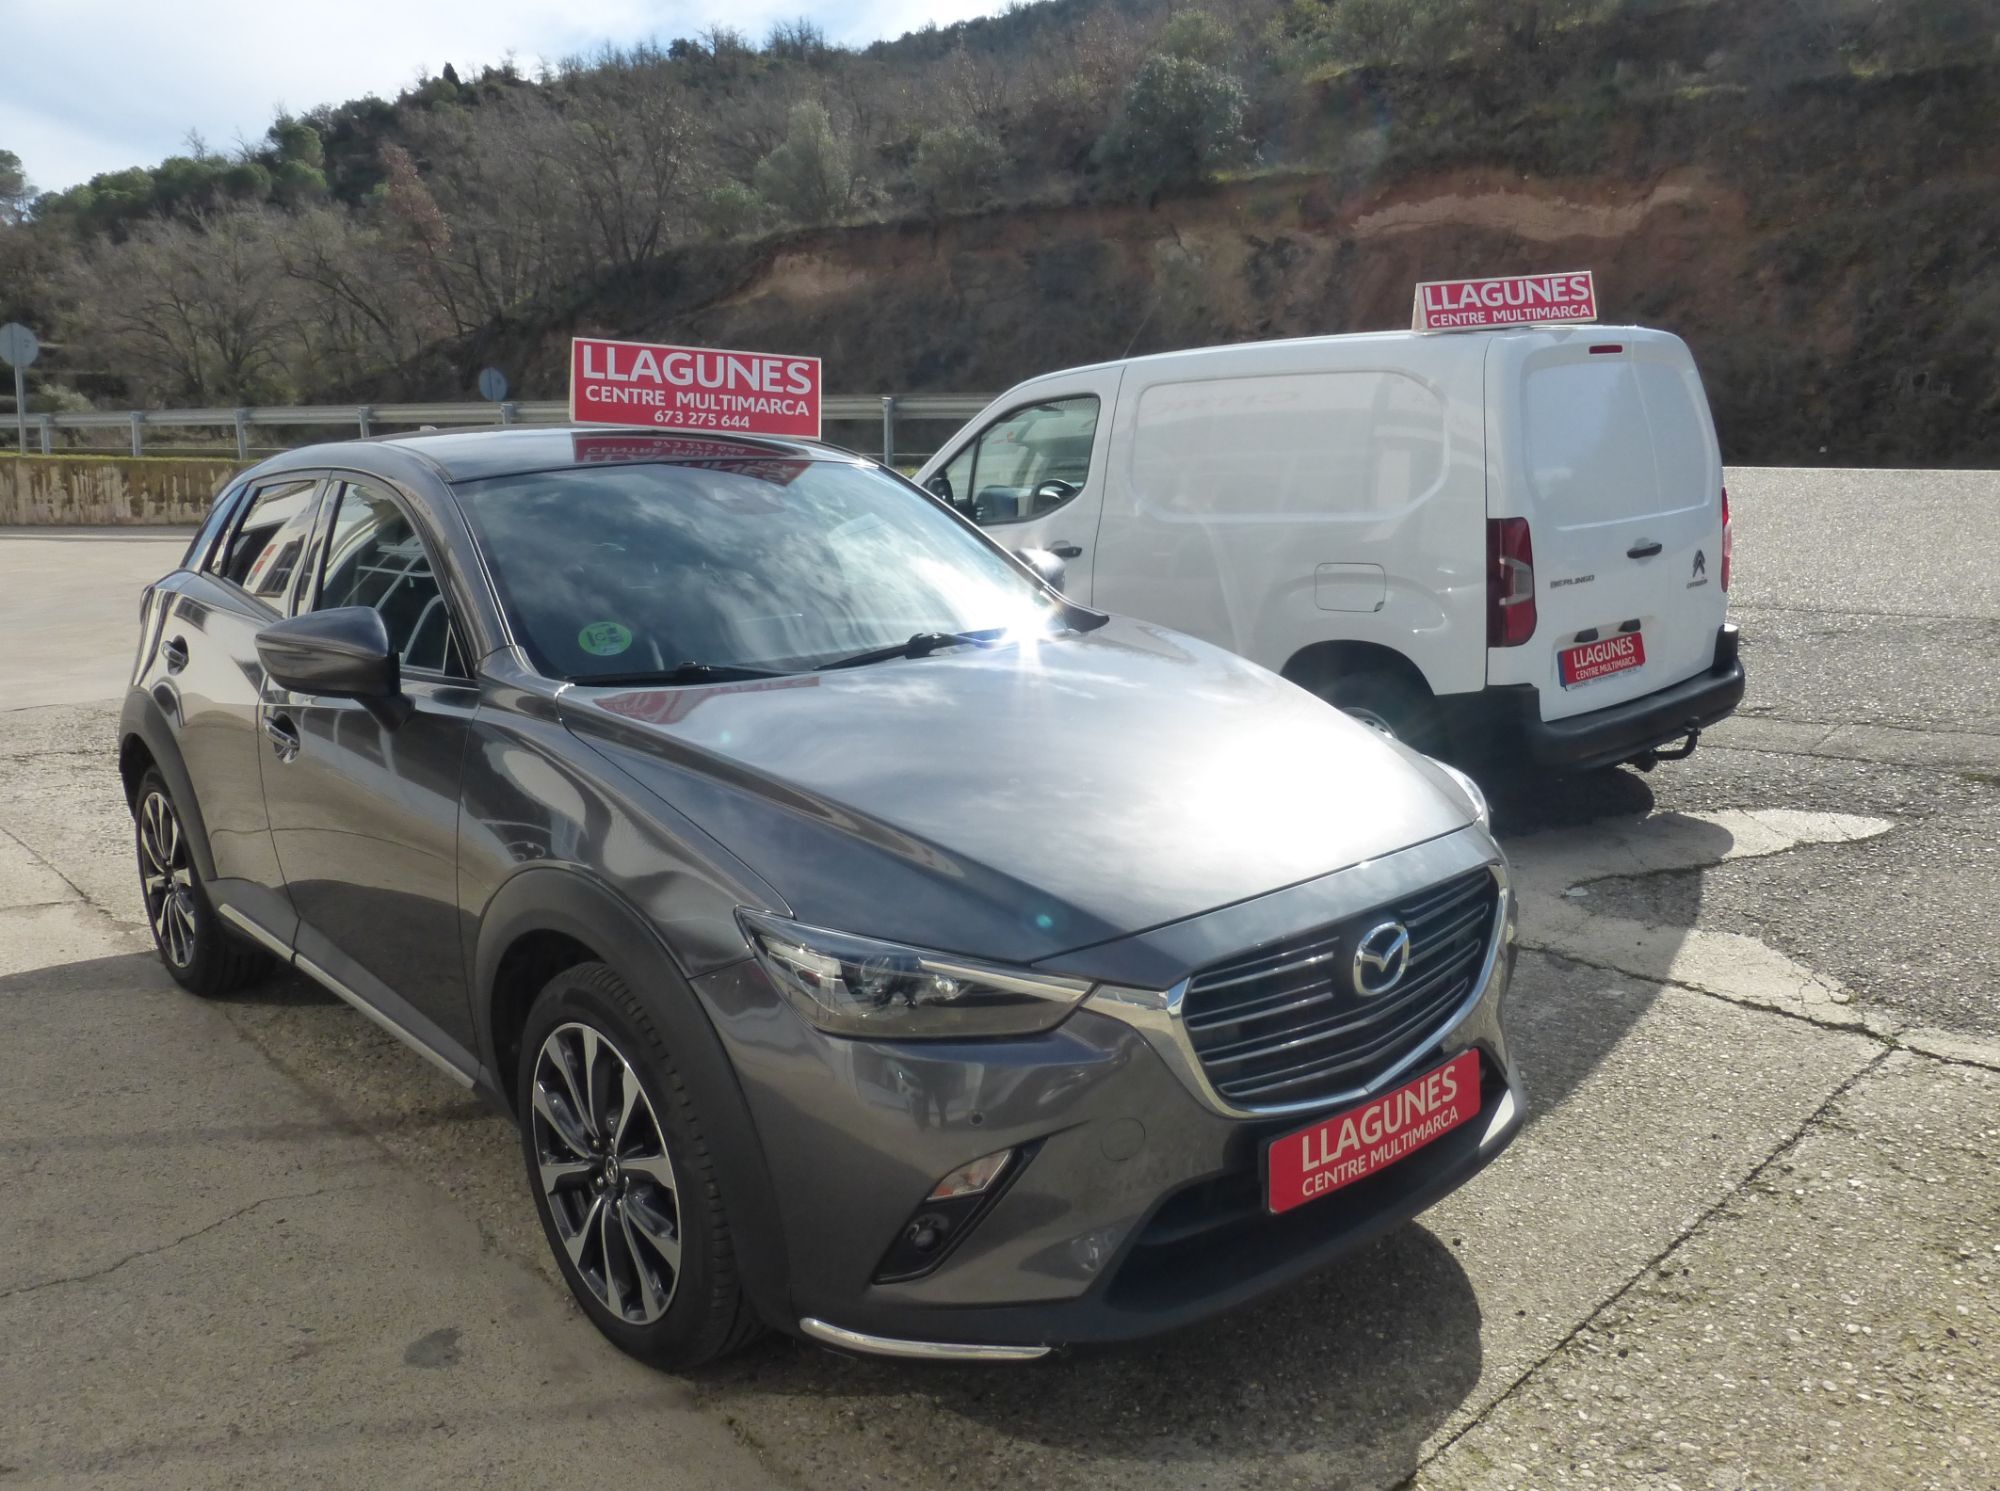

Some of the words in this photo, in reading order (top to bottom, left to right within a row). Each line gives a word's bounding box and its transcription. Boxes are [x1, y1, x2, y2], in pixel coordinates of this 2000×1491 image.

[1425, 277, 1589, 311] LLAGUNES
[1430, 311, 1485, 327] CENTRE
[1493, 305, 1590, 323] MULTIMARCA
[583, 345, 812, 395] LLAGUNES
[585, 385, 666, 406] CENTRE
[676, 391, 810, 416] MULTIMARCA
[654, 411, 684, 424] 673
[688, 412, 717, 426] 275
[721, 415, 750, 428] 644
[1550, 575, 1595, 589] BERLINGO
[1573, 636, 1634, 668] LLAGUNES
[1576, 666, 1600, 680] CENTRE
[1600, 656, 1636, 673] MULTIMARCA
[1302, 1065, 1457, 1172] LLAGUNES
[1302, 1155, 1367, 1197] CENTRE
[1370, 1105, 1459, 1168] MULTIMARCA
